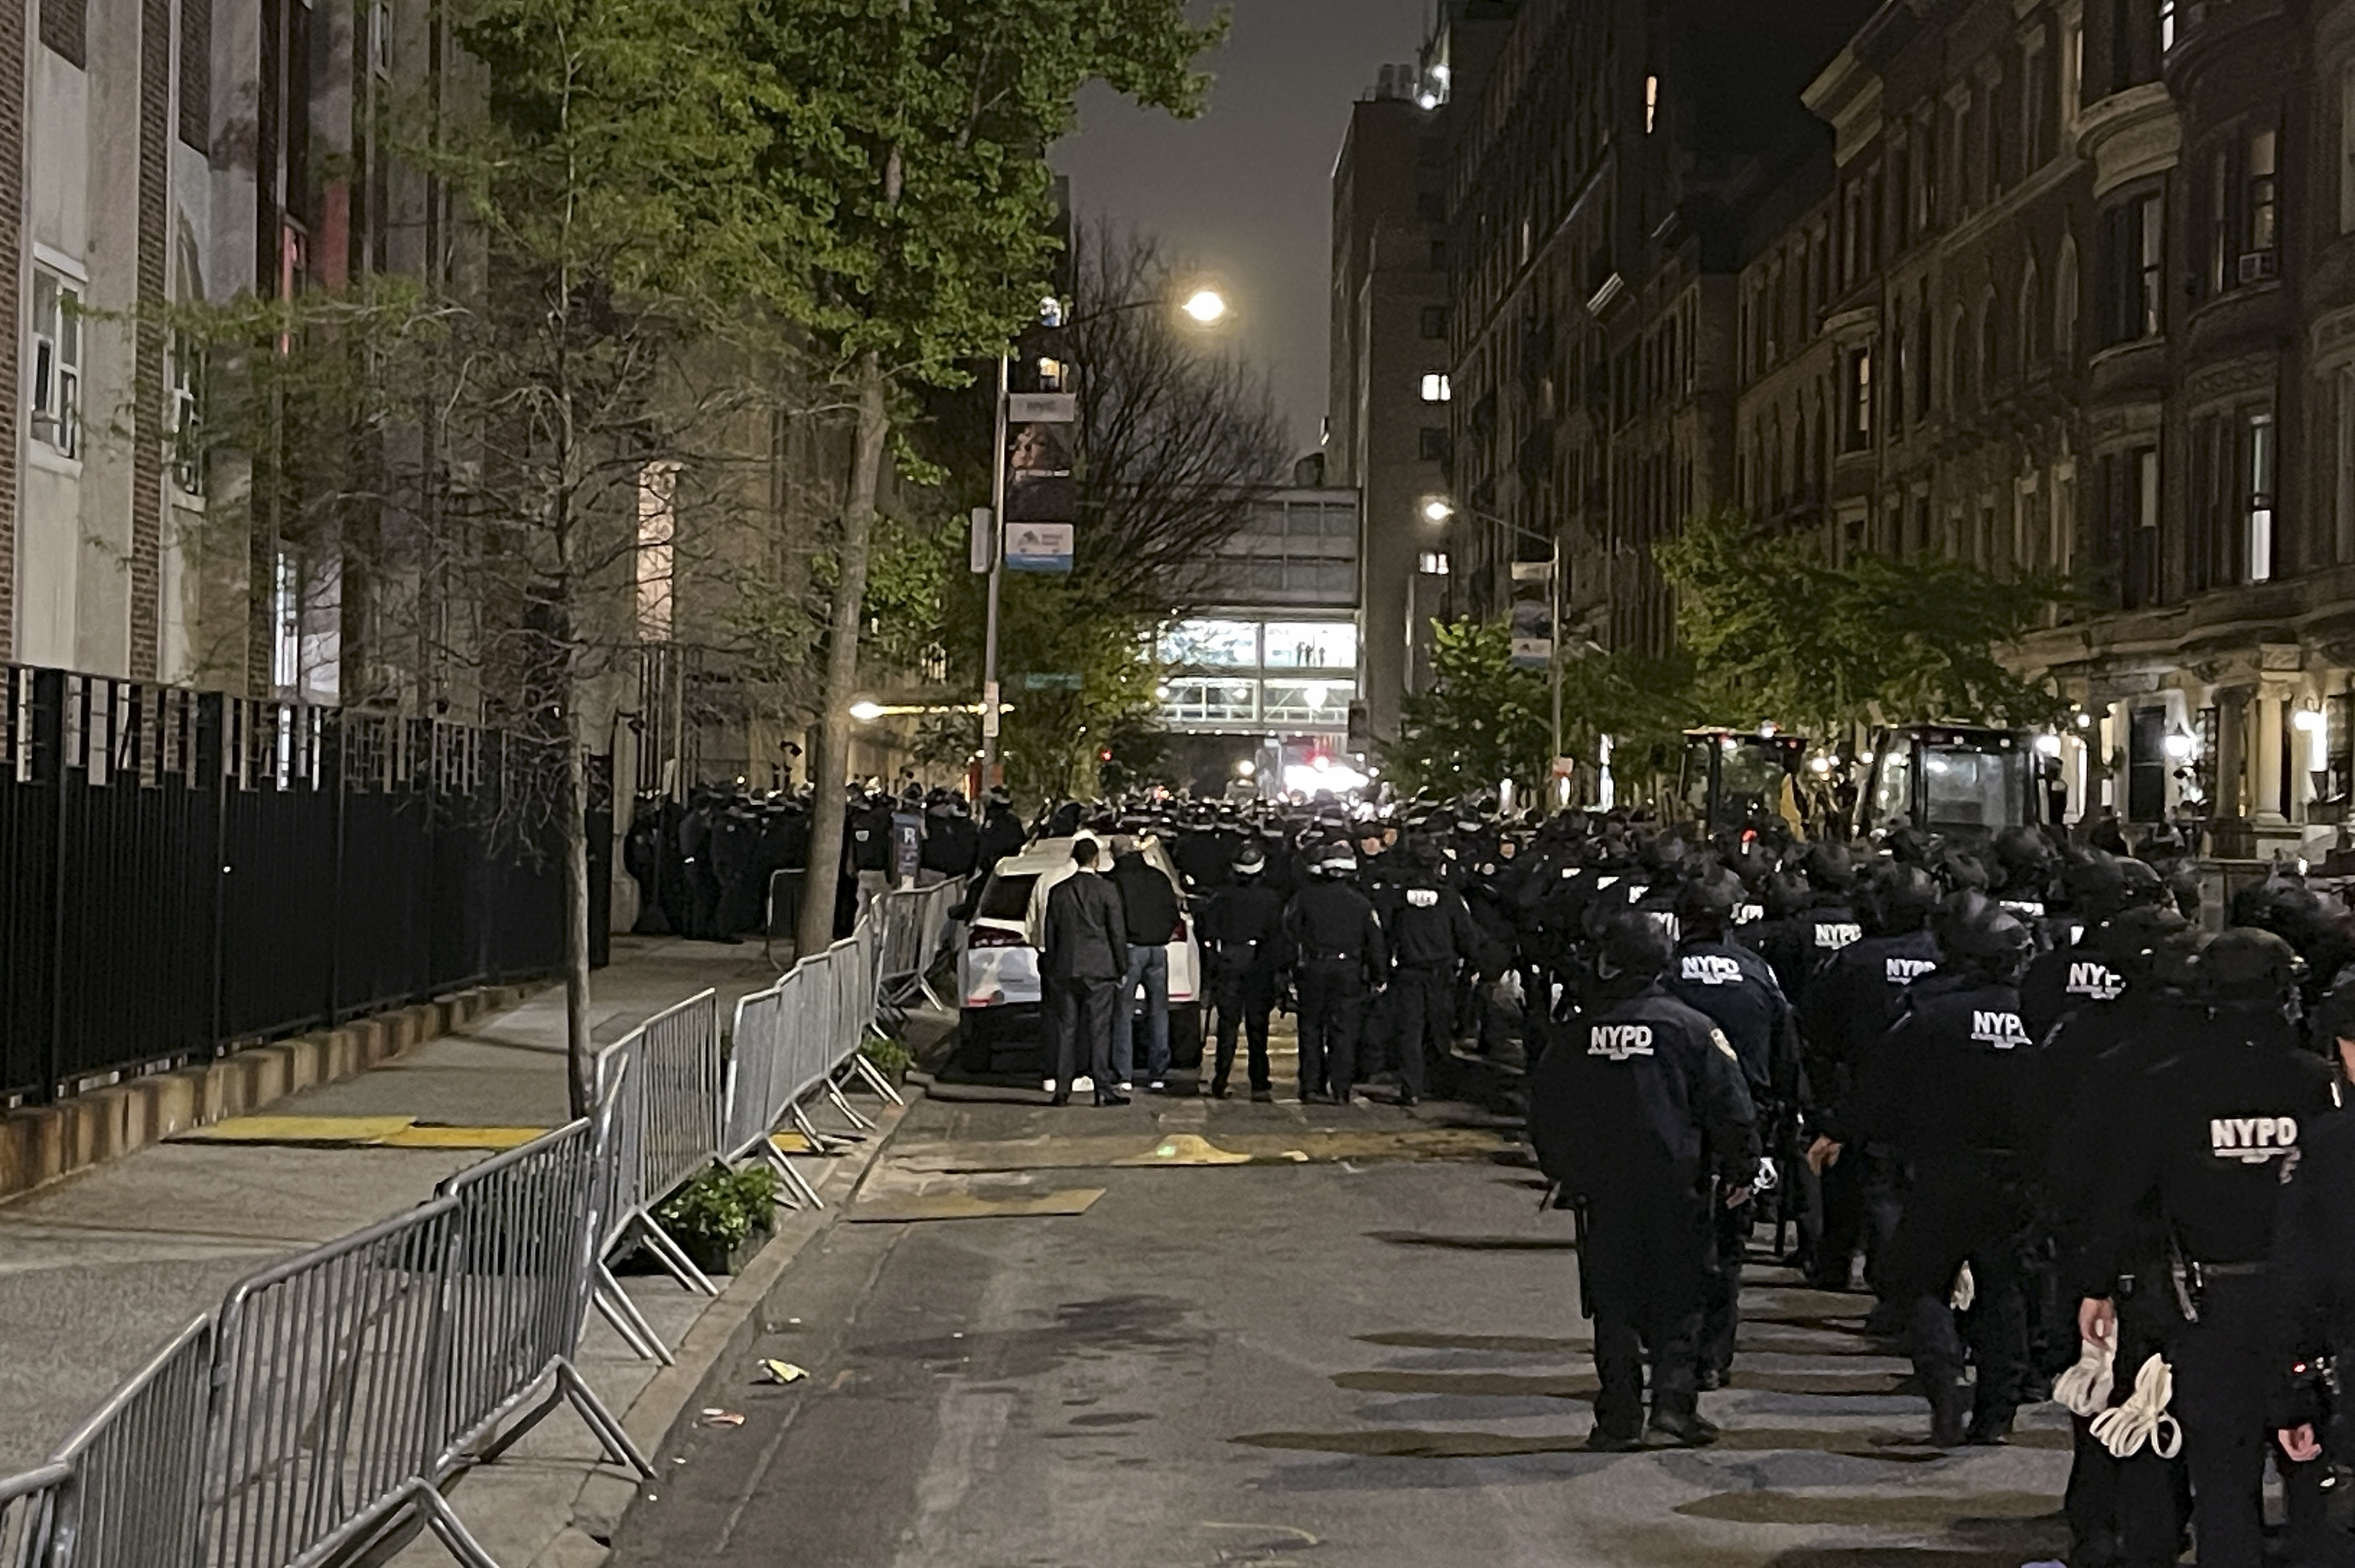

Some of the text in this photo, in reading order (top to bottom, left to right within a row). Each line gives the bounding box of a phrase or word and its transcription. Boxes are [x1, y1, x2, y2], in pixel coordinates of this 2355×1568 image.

[1815, 924, 1861, 942] NYPD
[1682, 955, 1739, 975] NYPD
[1974, 1010, 2025, 1036] NYP
[1591, 1025, 1652, 1048] NYPD
[2211, 1117, 2298, 1147] NYPD
